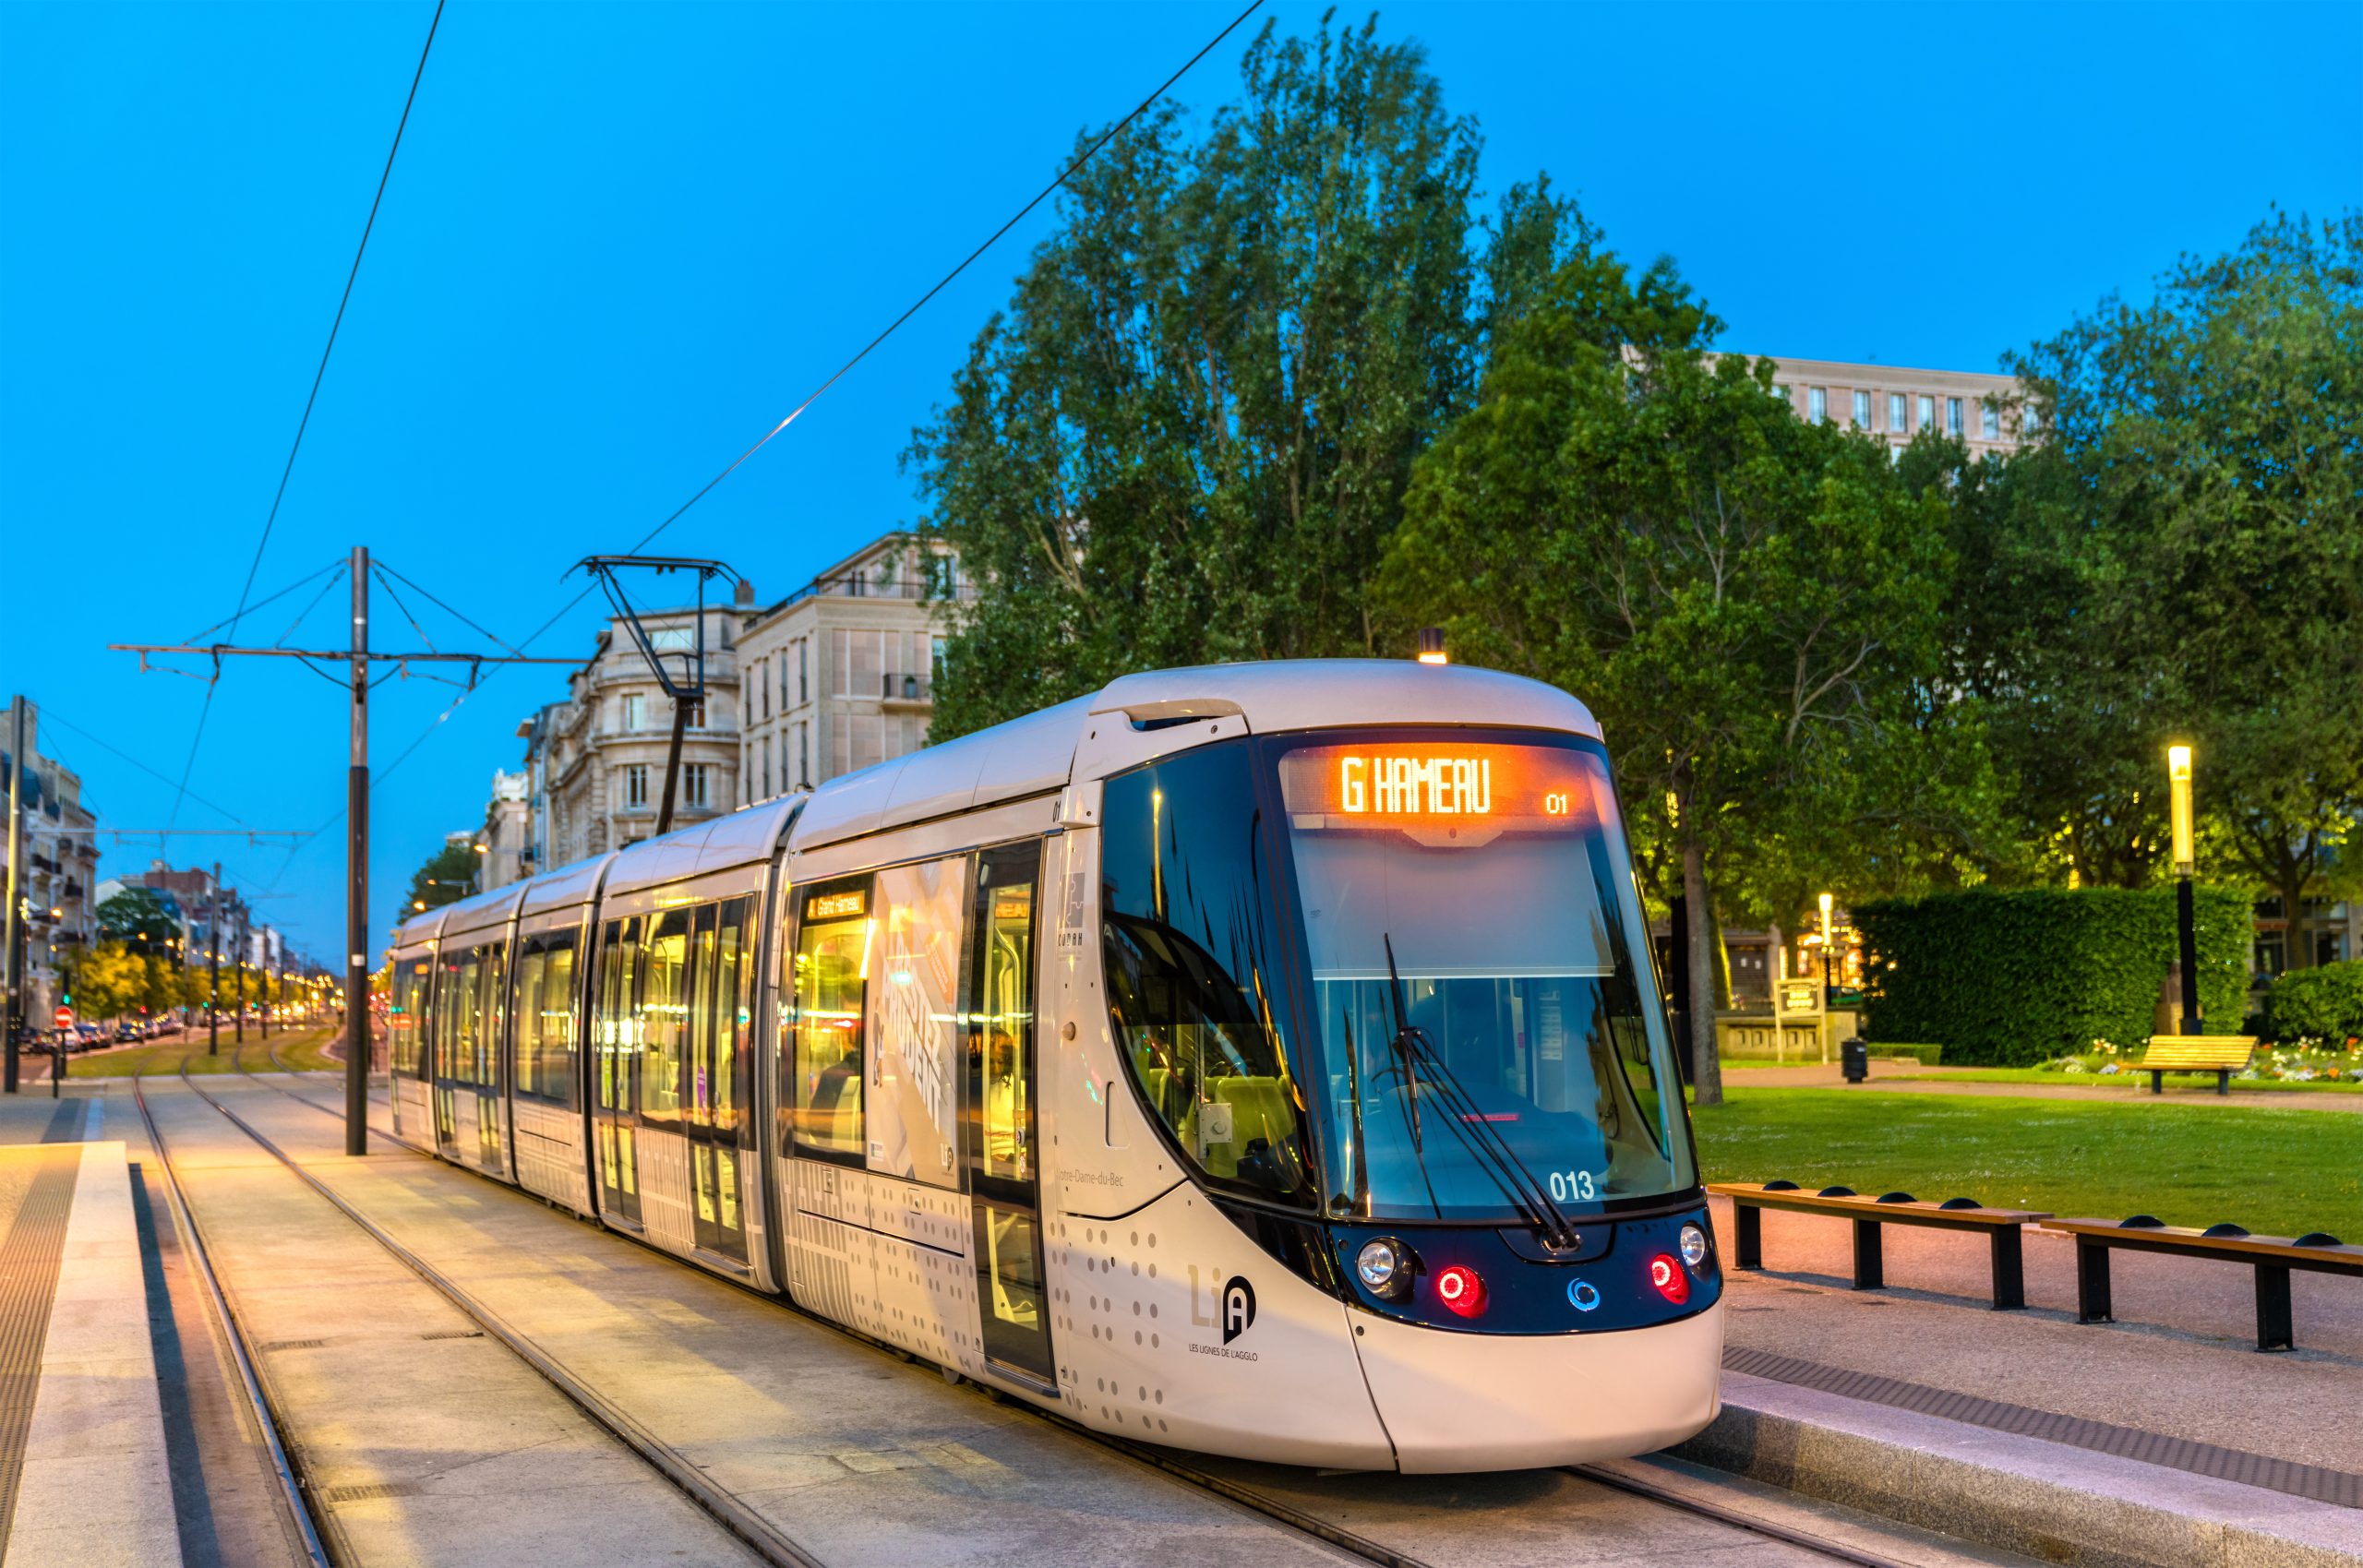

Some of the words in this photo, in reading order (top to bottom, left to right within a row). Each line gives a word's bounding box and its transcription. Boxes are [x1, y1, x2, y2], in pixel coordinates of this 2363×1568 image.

[1341, 757, 1363, 812] G
[1373, 757, 1491, 814] HAMEAU
[1545, 793, 1568, 814] 01
[1549, 1170, 1595, 1202] 013
[1188, 1343, 1199, 1353] LES
[1200, 1345, 1220, 1357] LIGNES
[1221, 1348, 1229, 1358] DE
[1230, 1349, 1258, 1362] L'AGGLO
